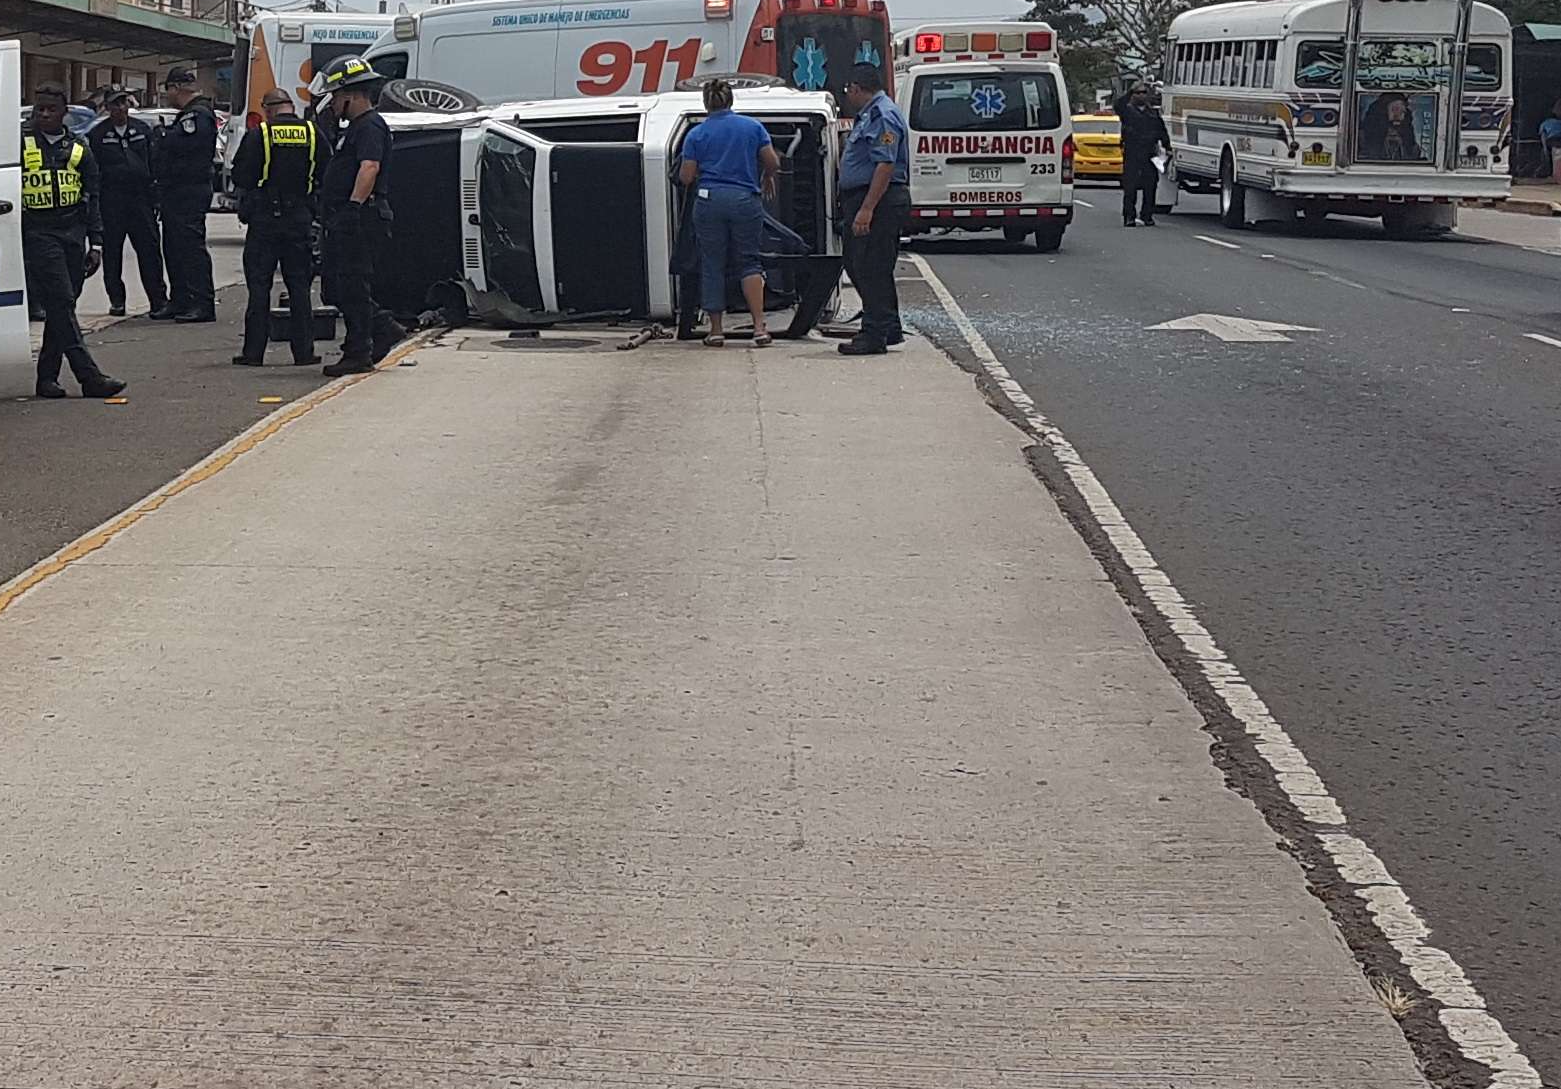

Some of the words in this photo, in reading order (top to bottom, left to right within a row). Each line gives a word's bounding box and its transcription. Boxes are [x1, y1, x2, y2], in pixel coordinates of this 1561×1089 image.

[492, 16, 518, 26] SISTEMA
[539, 13, 548, 24] DE
[574, 11, 583, 21] DE
[584, 8, 630, 20] EMERGENCIAS
[576, 37, 701, 97] 911
[273, 129, 306, 140] POLICIA
[916, 135, 1056, 155] AMBULANCIA
[1030, 163, 1056, 175] 233
[949, 191, 1022, 203] BOMBEROS
